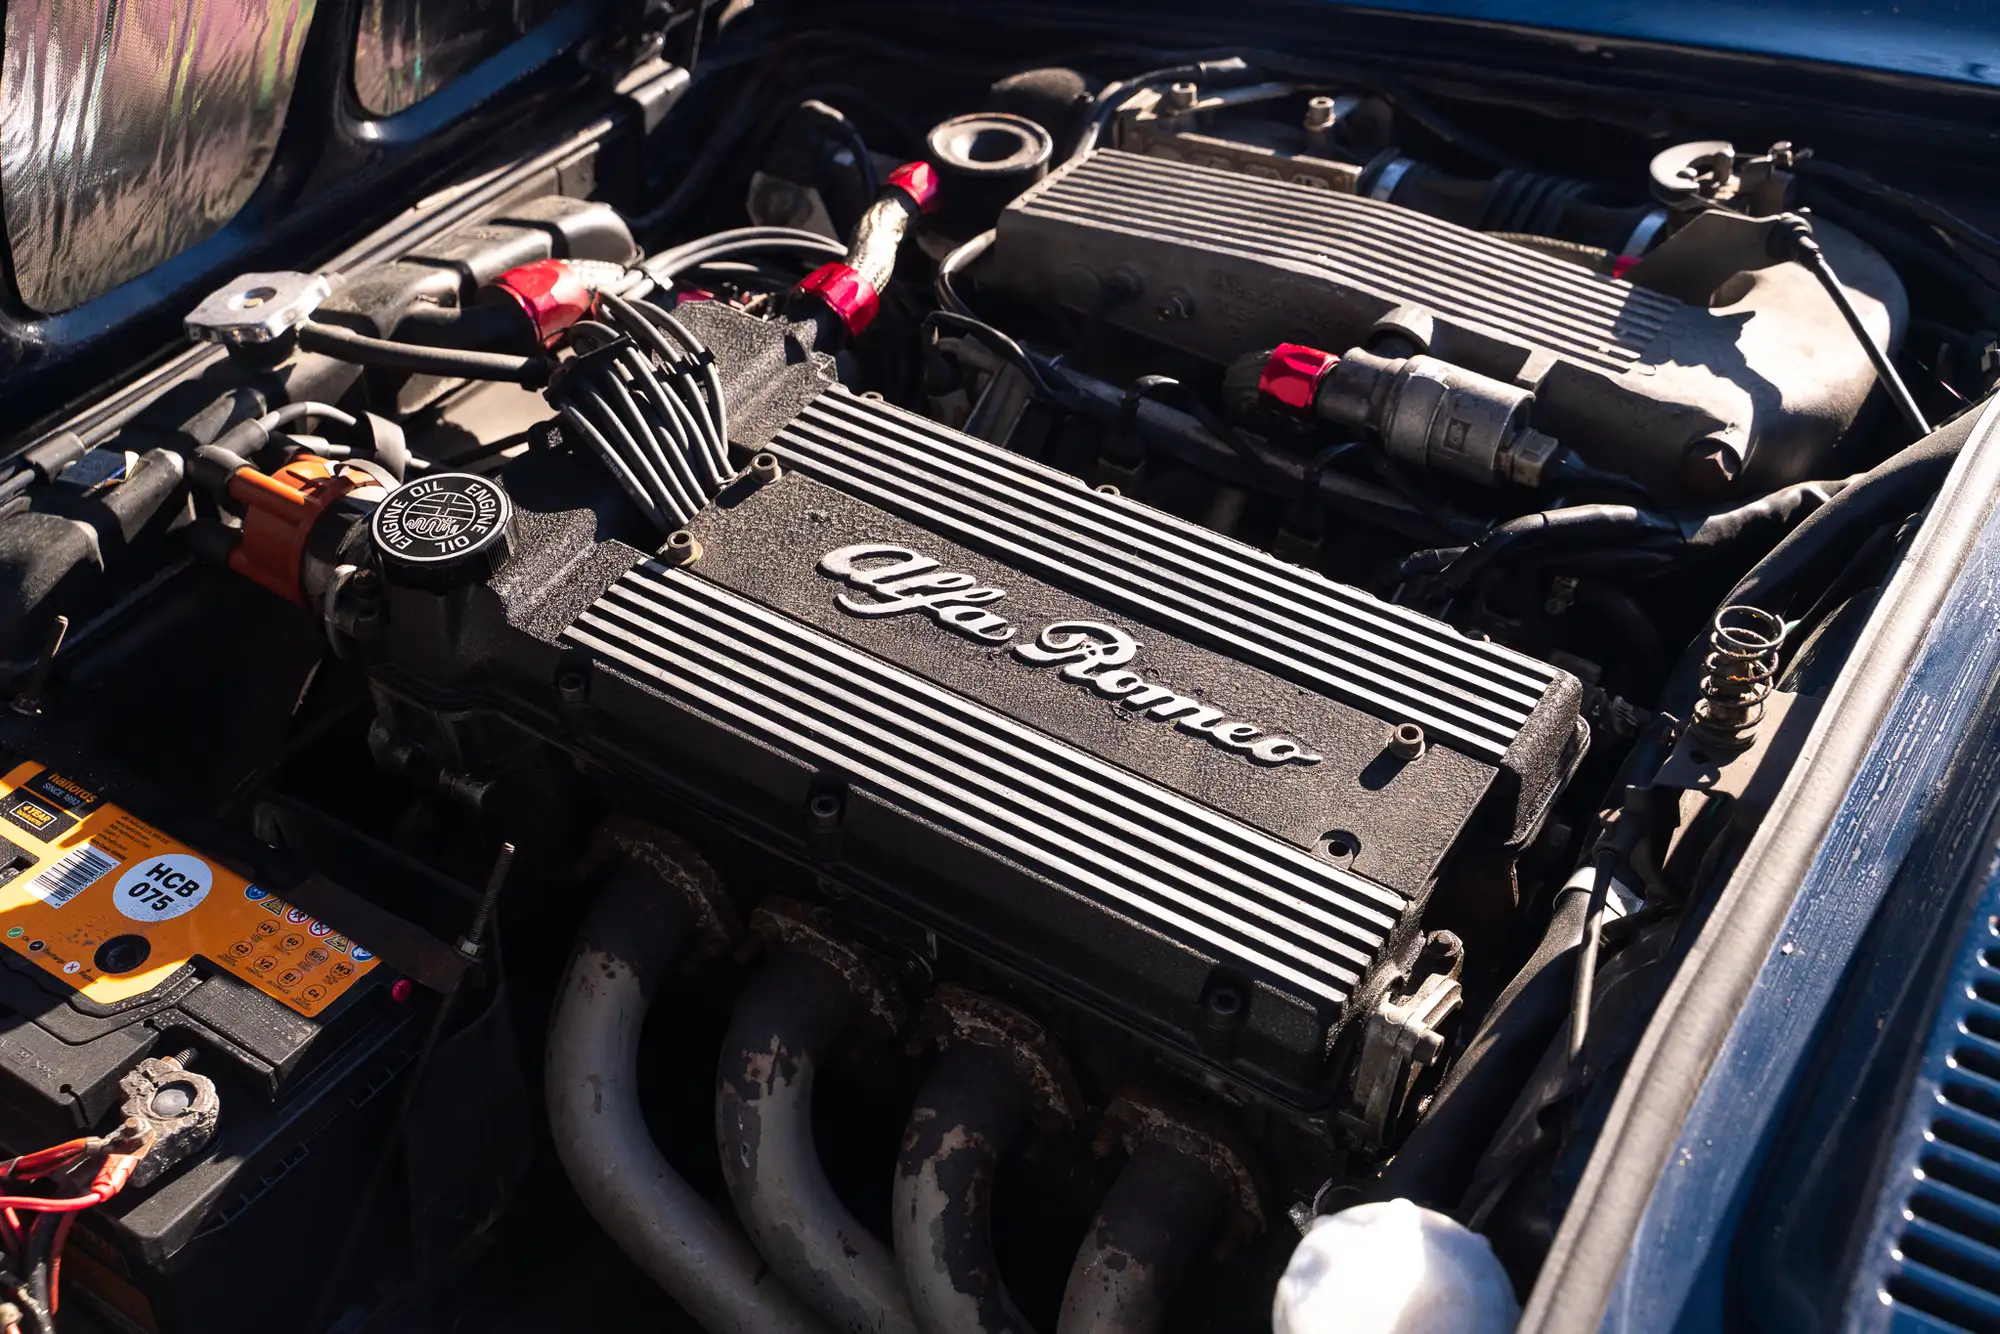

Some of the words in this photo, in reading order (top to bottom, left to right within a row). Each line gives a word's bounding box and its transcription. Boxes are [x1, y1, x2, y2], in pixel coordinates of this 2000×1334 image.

[382, 498, 413, 550] ENGINE
[409, 480, 444, 498] OIL
[464, 483, 497, 535] ENGINE
[434, 535, 470, 553] OIL
[819, 543, 1017, 641] Alfa
[1011, 620, 1323, 766] Romeo
[42, 782, 65, 798] SINCE
[47, 771, 98, 804] halfords
[28, 805, 52, 823] YEAR
[145, 862, 200, 898] HCB
[128, 882, 175, 911] 075
[260, 923, 277, 934] 12V
[235, 944, 249, 954] C2
[260, 958, 273, 969] V2
[336, 963, 352, 975] W3
[308, 989, 320, 998] Ca
